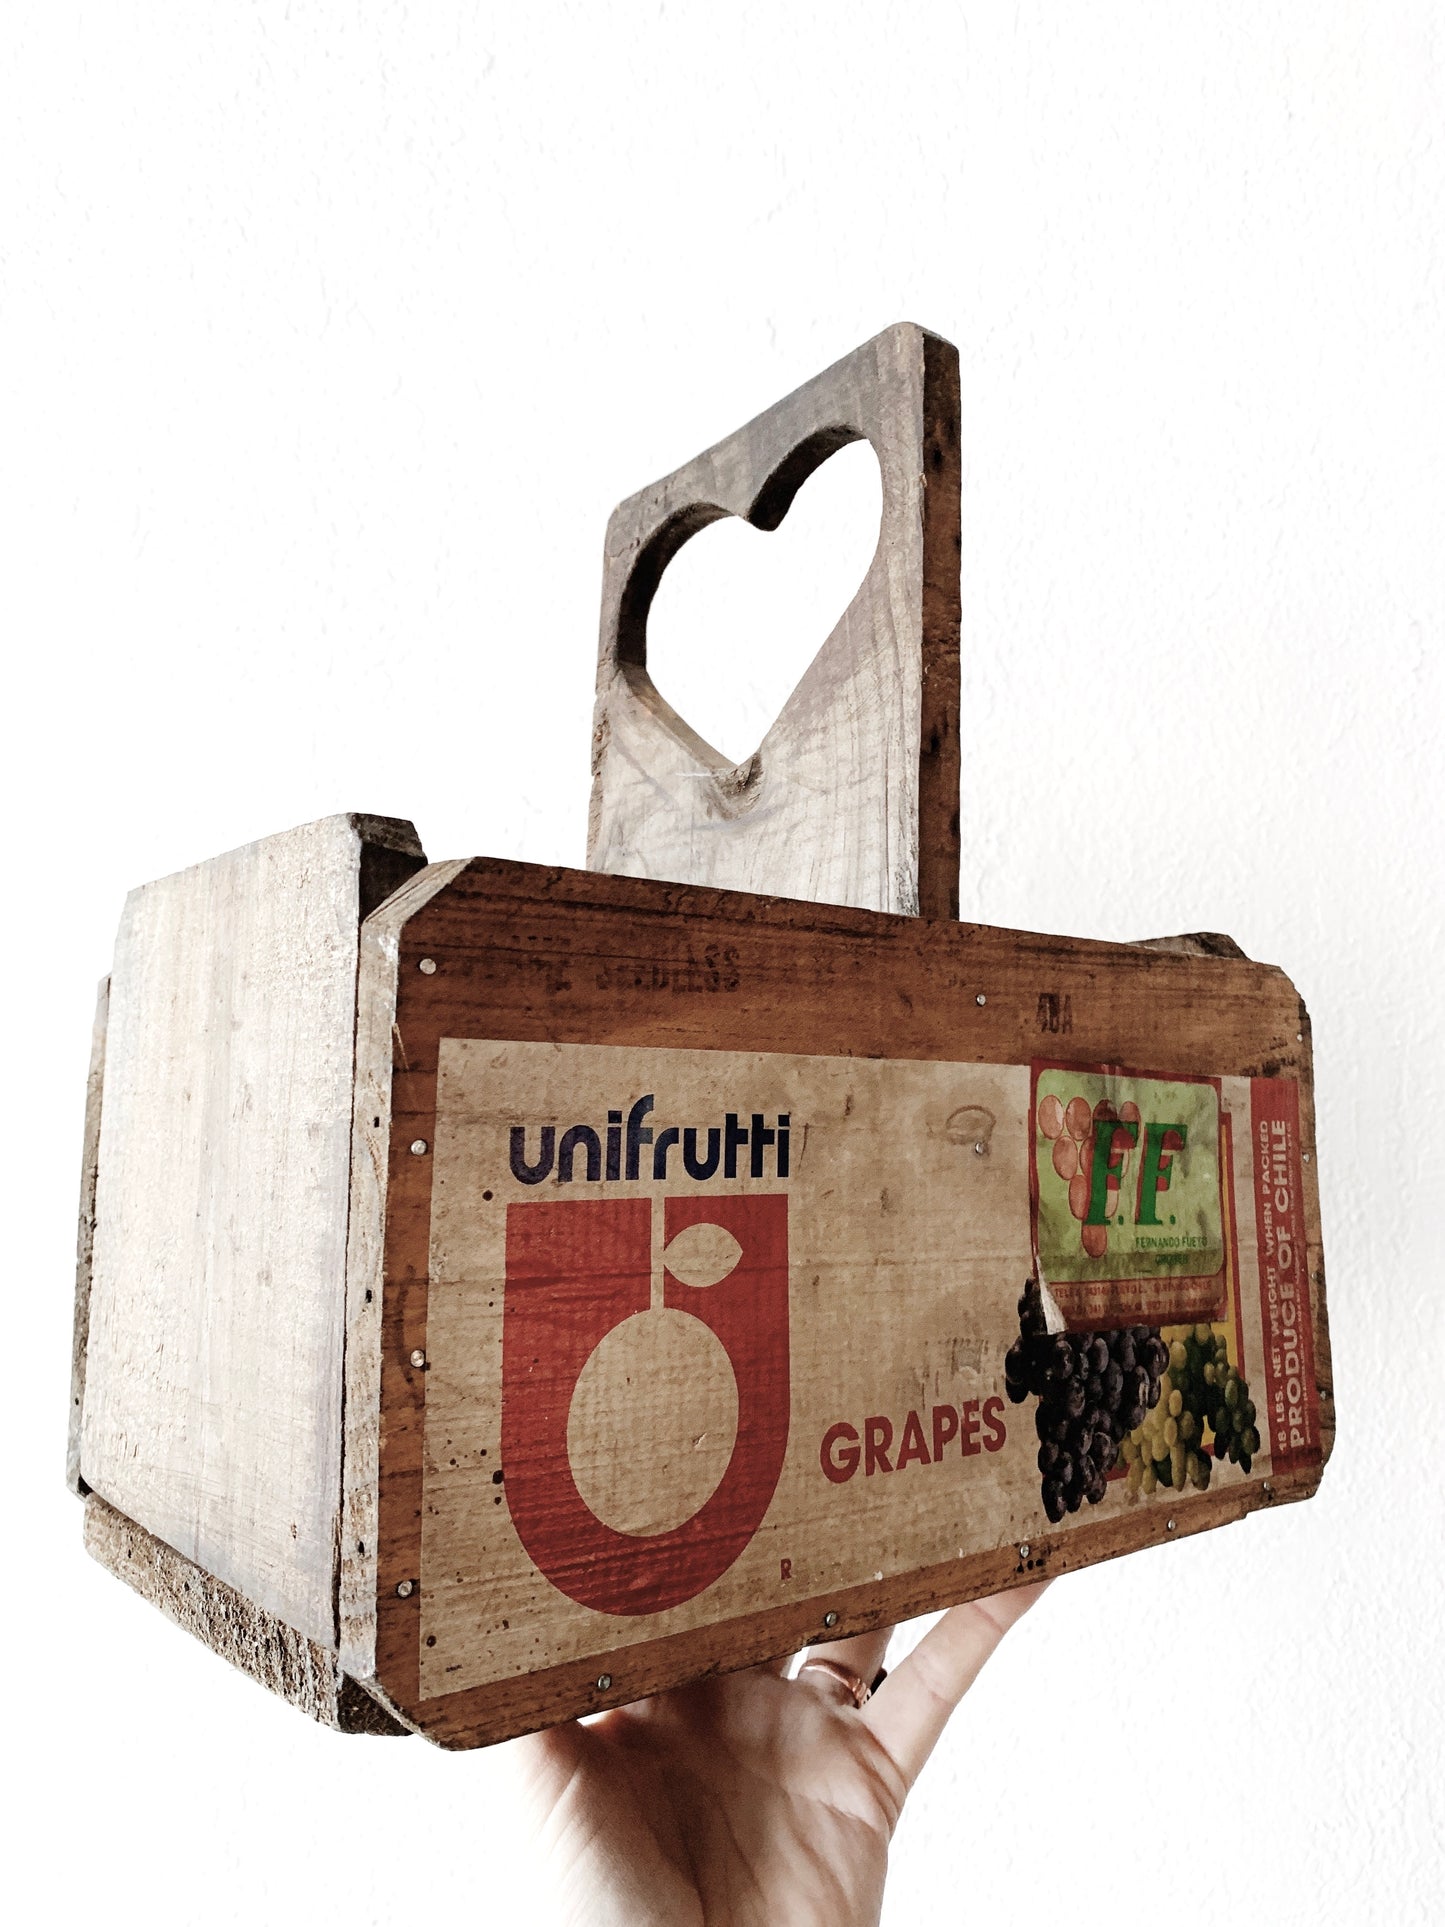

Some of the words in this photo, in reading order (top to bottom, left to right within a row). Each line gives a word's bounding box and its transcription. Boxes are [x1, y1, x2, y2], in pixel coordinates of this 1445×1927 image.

[509, 1093, 790, 1185] unifrutti
[1259, 1120, 1271, 1194] PACKED
[1271, 1120, 1289, 1213] CHILE
[1263, 1202, 1275, 1256] WHEN
[1276, 1226, 1292, 1270] OF
[1267, 1265, 1281, 1336] WEIGHT
[1272, 1347, 1282, 1378] NET
[1279, 1281, 1305, 1449] PRODUCE
[1275, 1386, 1285, 1423] LBS.
[820, 1396, 1006, 1483] GRAPES
[1278, 1430, 1287, 1450] 18
[780, 1558, 792, 1580] R
